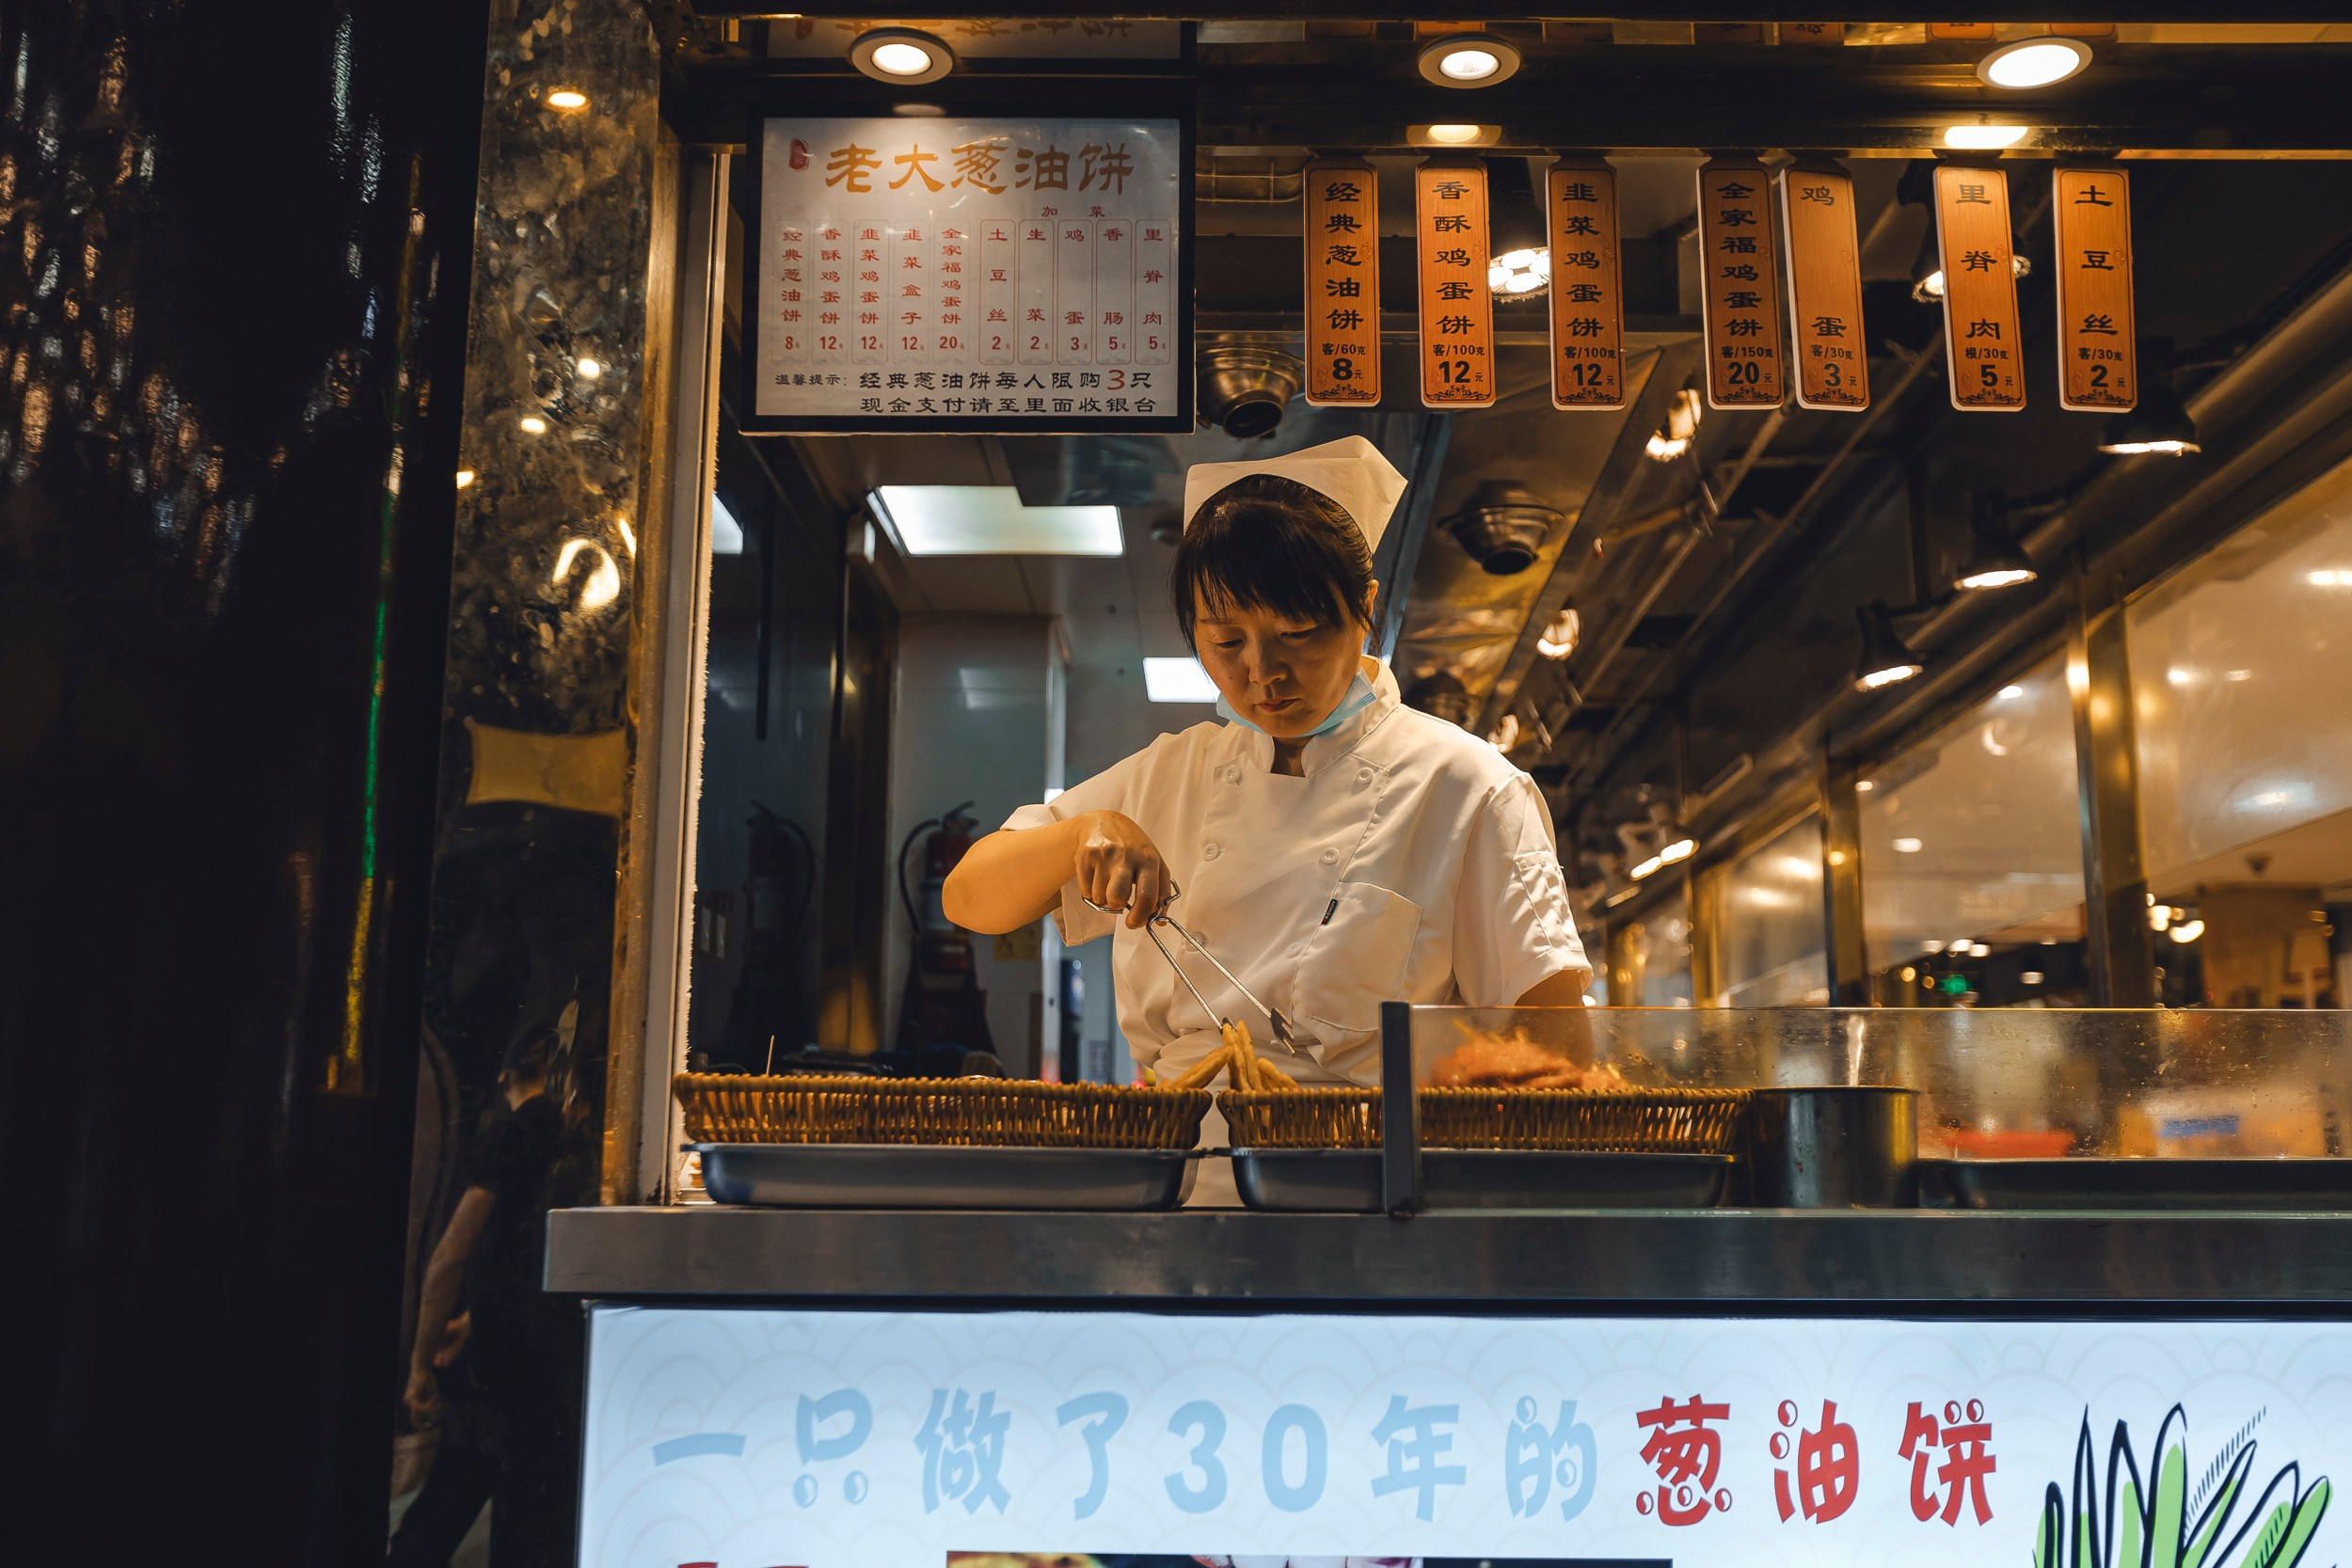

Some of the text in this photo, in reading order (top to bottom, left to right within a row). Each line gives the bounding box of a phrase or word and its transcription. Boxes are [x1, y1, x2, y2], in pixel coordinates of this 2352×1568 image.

[824, 142, 1134, 195] 老大葱油饼
[782, 228, 803, 324] 经典葱油饼
[819, 228, 841, 325] 香酥鸡蛋饼
[859, 228, 881, 325] 韭菜鸡蛋饼
[901, 229, 923, 325] 韭菜盒子
[941, 228, 963, 325] 全家福鸡蛋饼
[988, 229, 1009, 324] 土豆丝
[1026, 229, 1047, 323] 生菜
[1065, 229, 1085, 325] 鸡蛋
[1104, 228, 1123, 325] 香肠
[1142, 229, 1164, 325] 里脊肉
[1325, 182, 1364, 331] 经典葱油饼
[1432, 181, 1475, 335] 香酥鸡蛋饼
[1562, 183, 1605, 338] 韭菜鸡蛋饼
[1716, 182, 1764, 337] 全家福鸡蛋饼
[1800, 185, 1848, 338] 鸡蛋
[1955, 184, 2001, 341] 里脊肉
[2074, 185, 2120, 336] 土豆丝
[859, 370, 1152, 391] 经典葱油饼每人限购3只
[1322, 342, 1366, 356] 客/60克
[1331, 358, 1363, 381] 8元
[1433, 344, 1486, 357] 客/100克
[1438, 360, 1484, 384] 12元
[1565, 346, 1616, 359] 客/100克
[1572, 363, 1615, 387] 12元
[1721, 346, 1774, 359] 客/150克
[1728, 362, 1772, 385] 20元
[1811, 344, 1853, 360] 客/30克
[1823, 362, 1858, 388] 3元
[1965, 347, 2009, 360] 根/30克
[1980, 364, 2014, 388] 5元
[2078, 348, 2122, 361] 客/30克
[2090, 365, 2126, 388] 2元
[860, 397, 1157, 414] 现金支付请至里面收银台
[651, 1385, 2003, 1528] 一只做了30年的葱油饼
